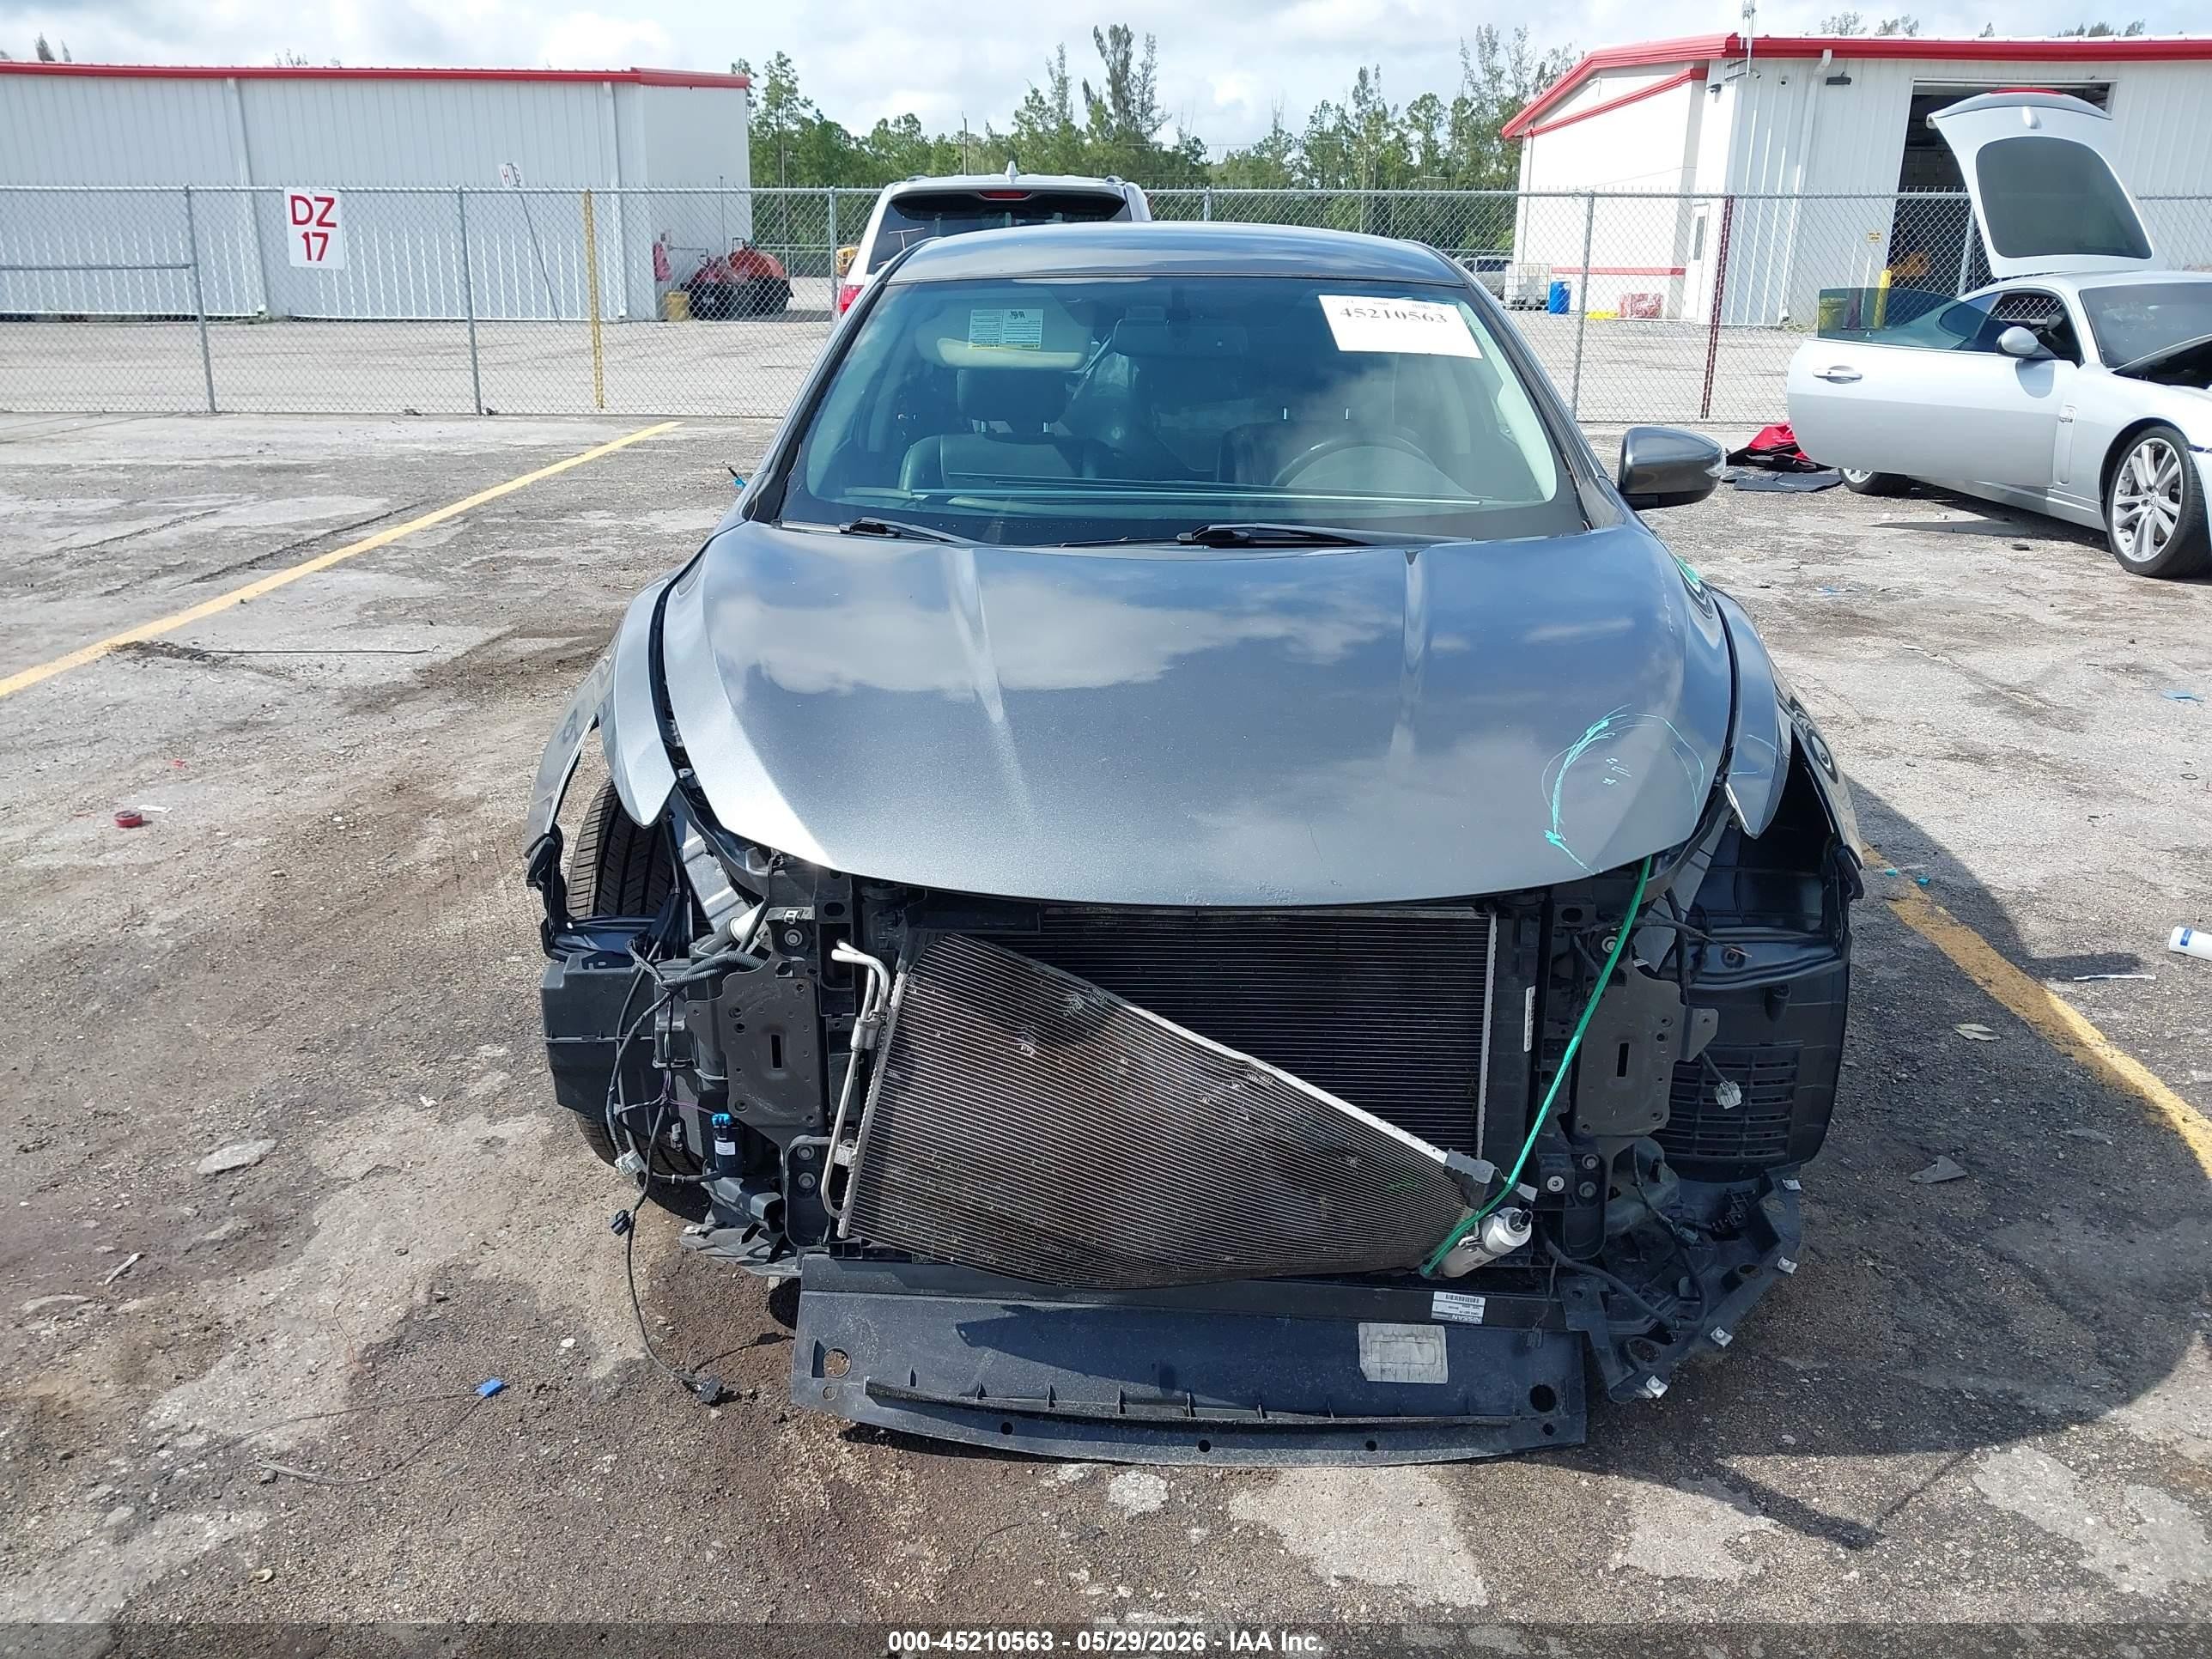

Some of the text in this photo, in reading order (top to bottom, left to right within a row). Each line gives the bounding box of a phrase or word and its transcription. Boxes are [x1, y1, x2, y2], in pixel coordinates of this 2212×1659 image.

[290, 195, 337, 228] DZ
[301, 231, 329, 261] 17
[1340, 307, 1449, 324] 45210563
